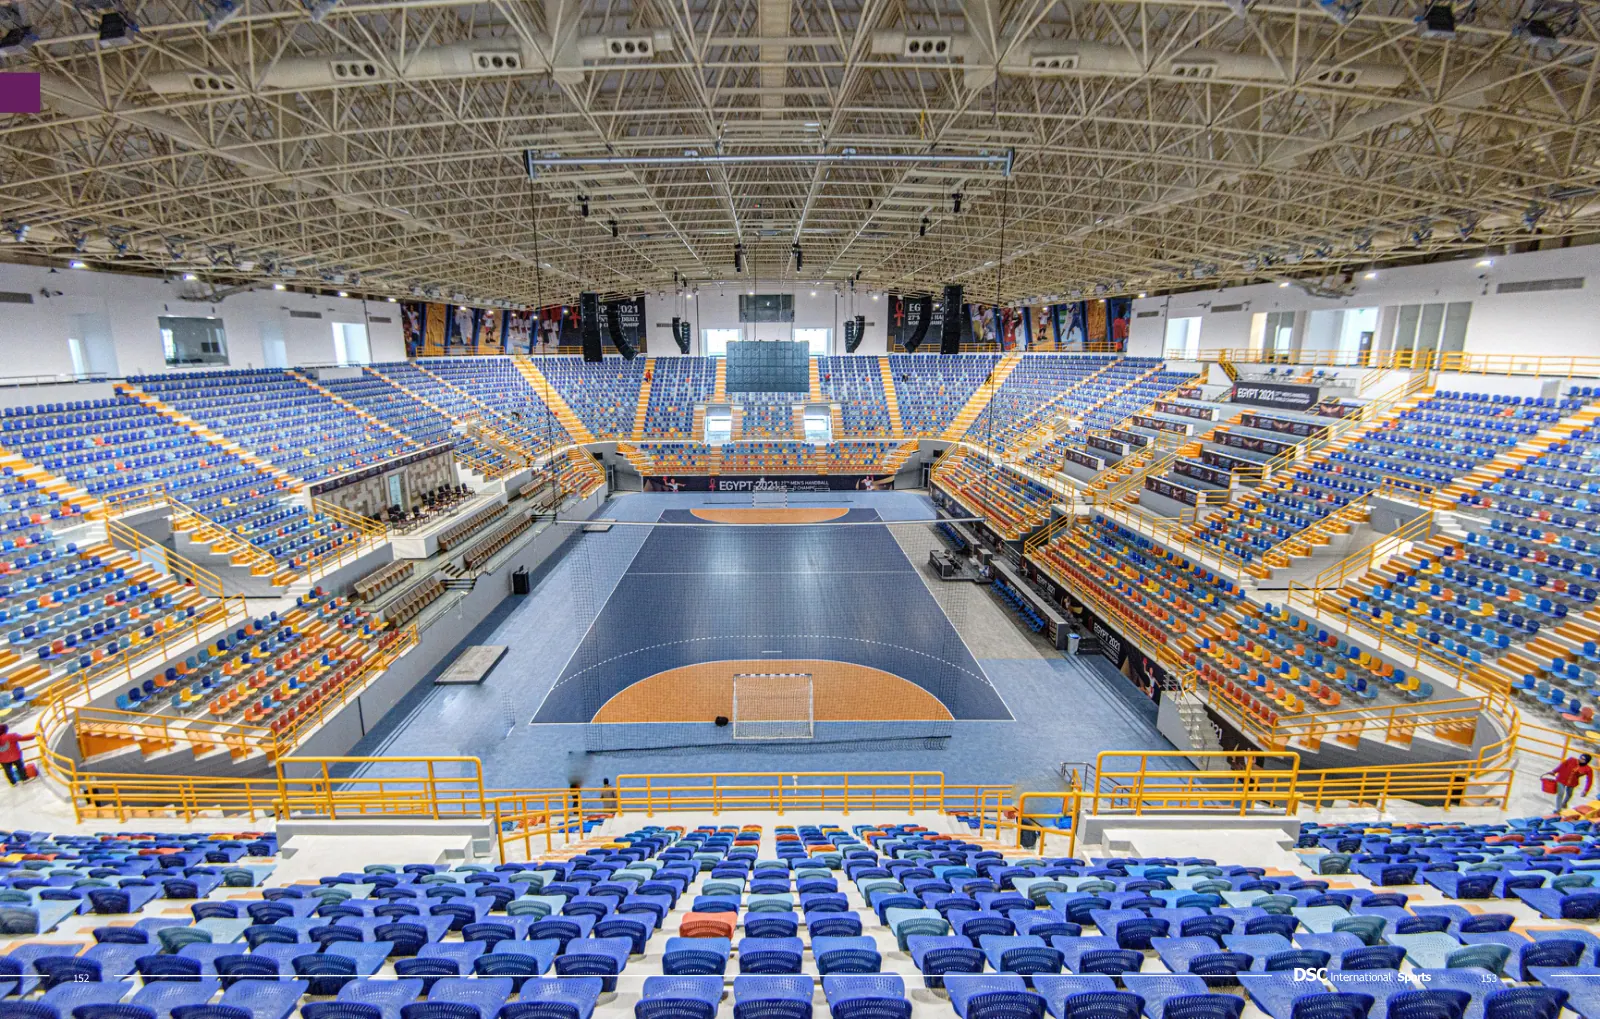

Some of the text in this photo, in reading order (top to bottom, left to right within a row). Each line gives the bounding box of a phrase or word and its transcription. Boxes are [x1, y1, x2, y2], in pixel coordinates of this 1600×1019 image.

[1237, 388, 1259, 398] EGYPT
[1259, 389, 1275, 400] 2021
[719, 481, 753, 491] EGYPT
[755, 480, 778, 490] 2021
[1093, 622, 1109, 641] EGYPT
[1109, 635, 1120, 652] 2021
